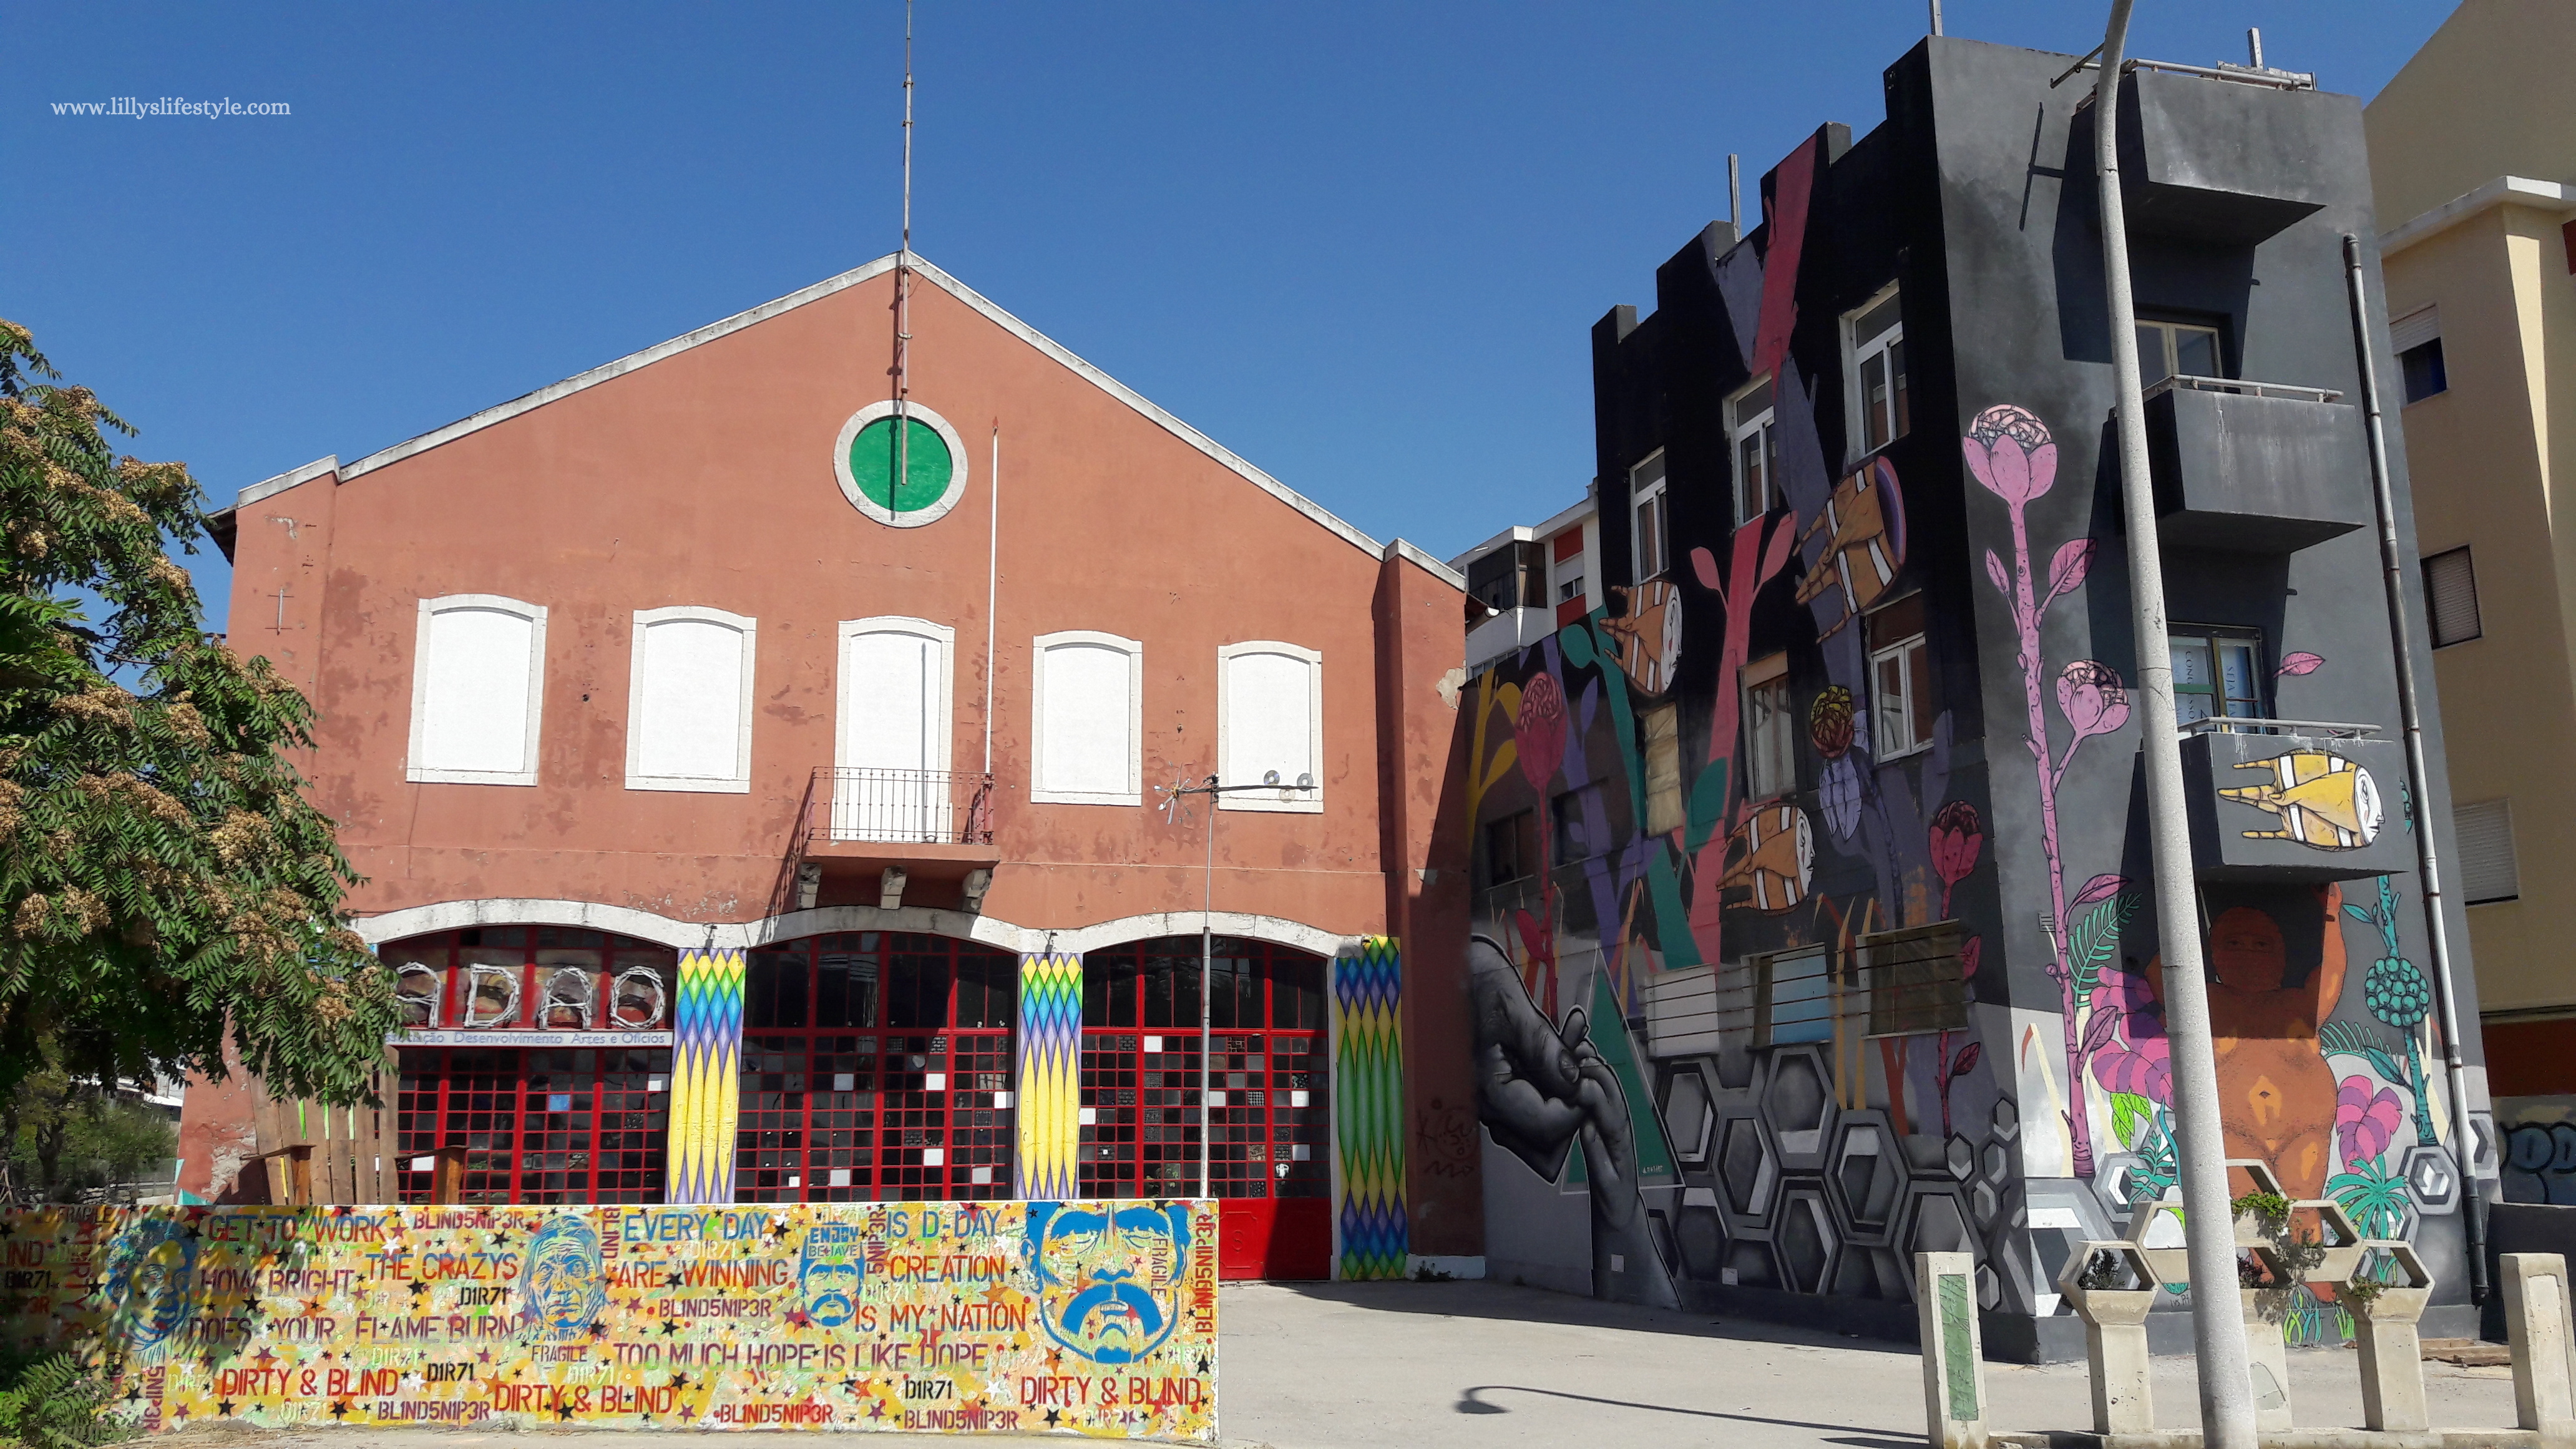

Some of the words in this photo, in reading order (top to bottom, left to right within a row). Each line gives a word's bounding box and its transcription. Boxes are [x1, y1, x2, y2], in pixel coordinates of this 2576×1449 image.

[454, 1032, 563, 1045] Desenvolvimento
[570, 1033, 605, 1045] Artes
[610, 1035, 618, 1044] e
[208, 1214, 258, 1242] GET
[266, 1214, 296, 1242] TO
[312, 1215, 388, 1242] WORK
[624, 1213, 710, 1242] EVERY
[723, 1212, 769, 1241] DAY
[809, 1226, 859, 1243] ENJOY
[886, 1211, 908, 1238] IS
[365, 1253, 414, 1280] THE
[422, 1252, 519, 1280] CRAZYS
[618, 1260, 666, 1288] ARE
[682, 1259, 788, 1287] WINNING
[890, 1255, 1005, 1282] CREATION
[1151, 1237, 1168, 1298] FRAGILE
[200, 1269, 263, 1297] HOW
[268, 1269, 355, 1297] BRIGHT
[188, 1317, 252, 1345] DOES
[273, 1317, 336, 1345] YOUR
[355, 1315, 443, 1345] FLAME
[447, 1315, 515, 1344] BURN
[855, 1304, 877, 1332] IS
[890, 1304, 927, 1332] MY
[940, 1304, 1027, 1332] NATION
[531, 1345, 588, 1362] FRAGILE
[613, 1342, 660, 1370] TOO
[670, 1343, 739, 1370] MUCH
[747, 1343, 816, 1371] HOPE
[824, 1343, 846, 1372] IS
[854, 1343, 912, 1372] LIKE
[920, 1343, 988, 1372] DOPE
[222, 1368, 292, 1397] DIRTY
[300, 1368, 318, 1396] &
[327, 1368, 399, 1397] BLIND
[1021, 1376, 1092, 1405] DIRTY
[1101, 1376, 1120, 1405] &
[1129, 1376, 1201, 1405] BLIND
[494, 1383, 567, 1413] DIRTY
[574, 1384, 592, 1413] &
[600, 1385, 674, 1413] BLIND
